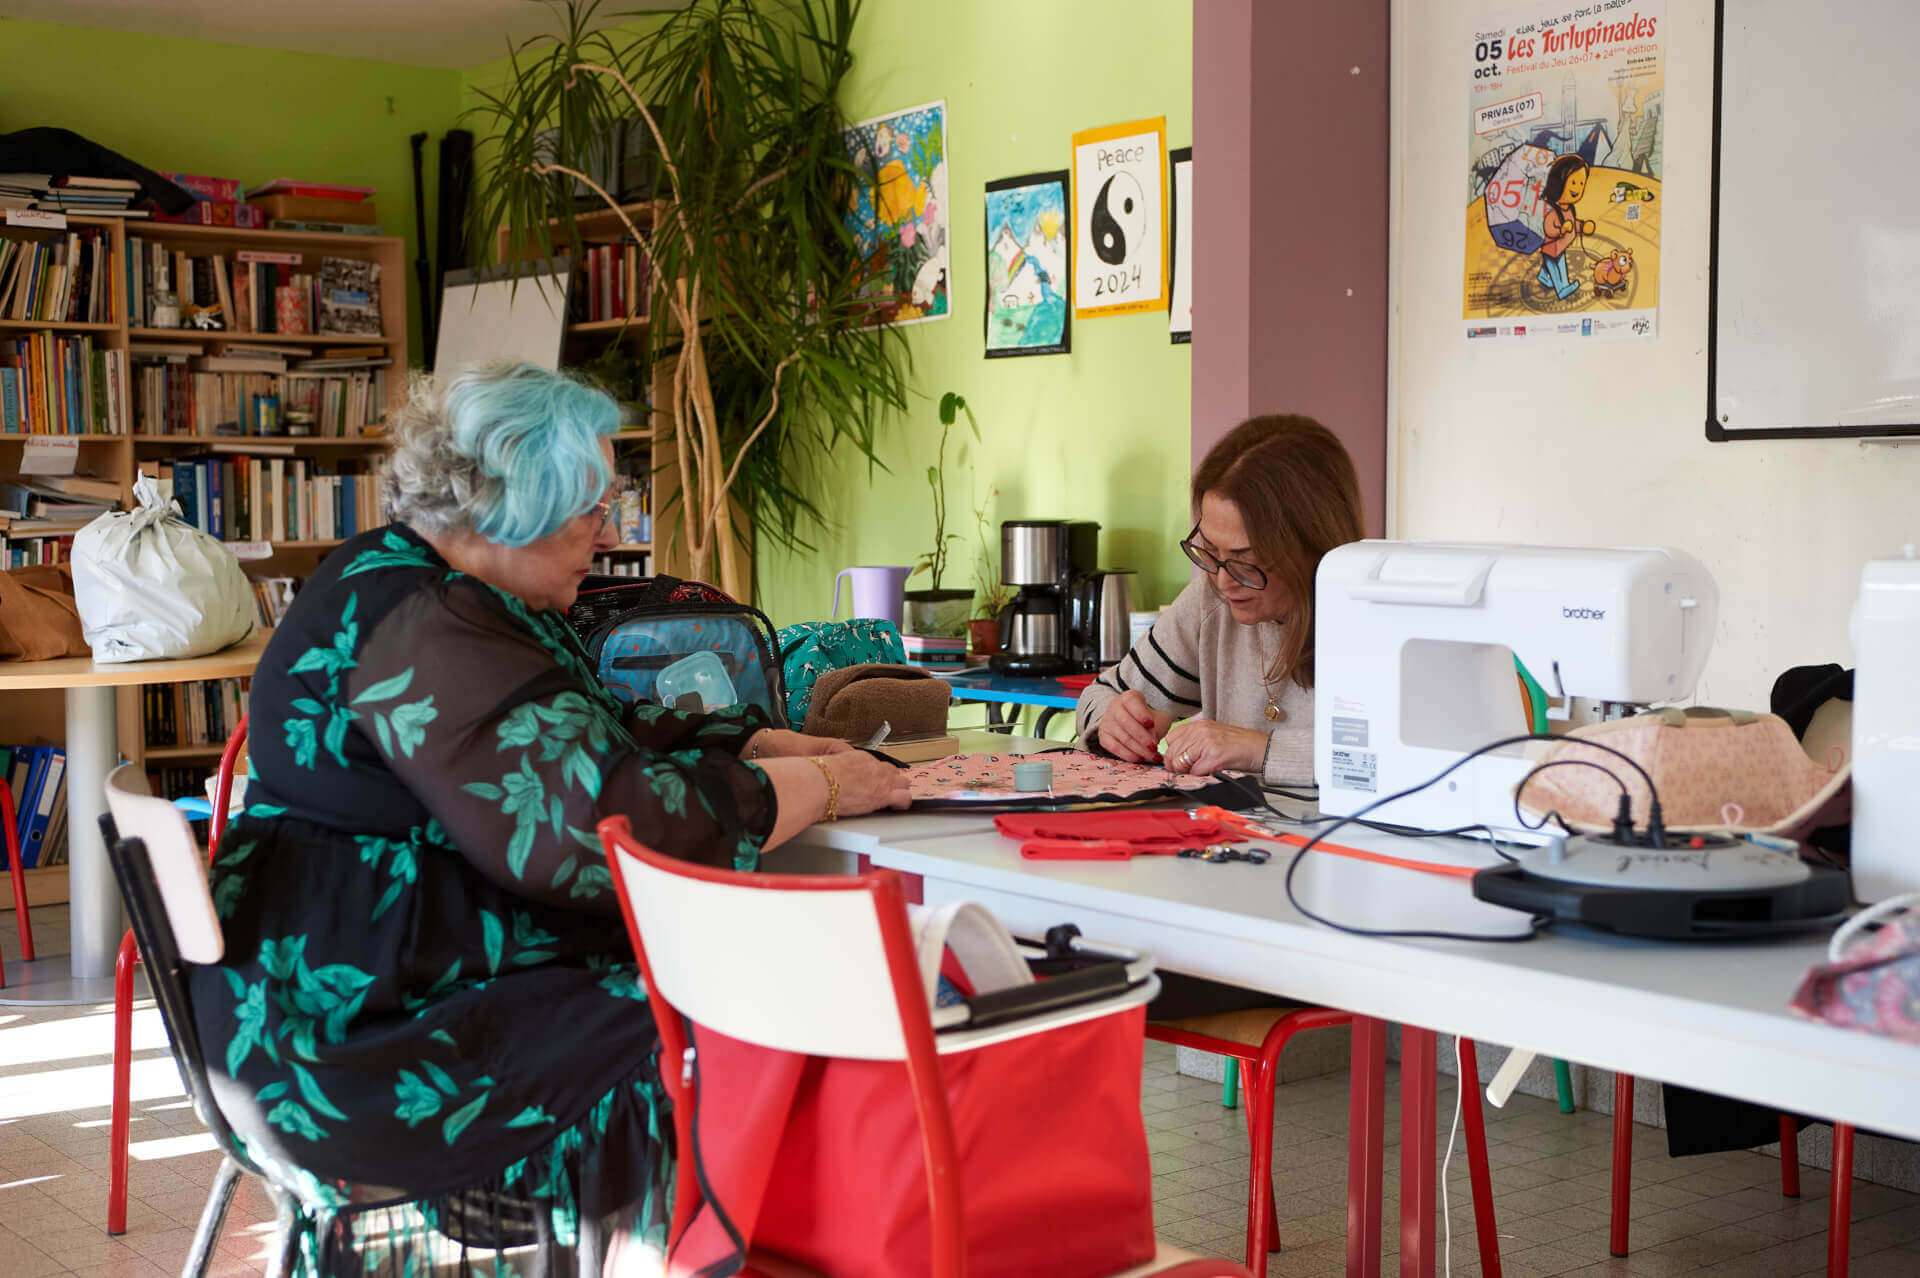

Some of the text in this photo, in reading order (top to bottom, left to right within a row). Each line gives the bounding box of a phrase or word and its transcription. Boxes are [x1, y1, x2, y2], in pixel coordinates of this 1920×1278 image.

[1508, 12, 1657, 61] Les Turlupinades
[1475, 39, 1502, 62] 05
[1474, 63, 1501, 79] oct.
[1506, 61, 1537, 75] Festival
[1551, 56, 1567, 67] Jeu
[1481, 98, 1535, 121] PRIVAS (07)
[1097, 146, 1144, 171] Peace
[1093, 264, 1141, 296] 2024
[1562, 605, 1606, 620] brother
